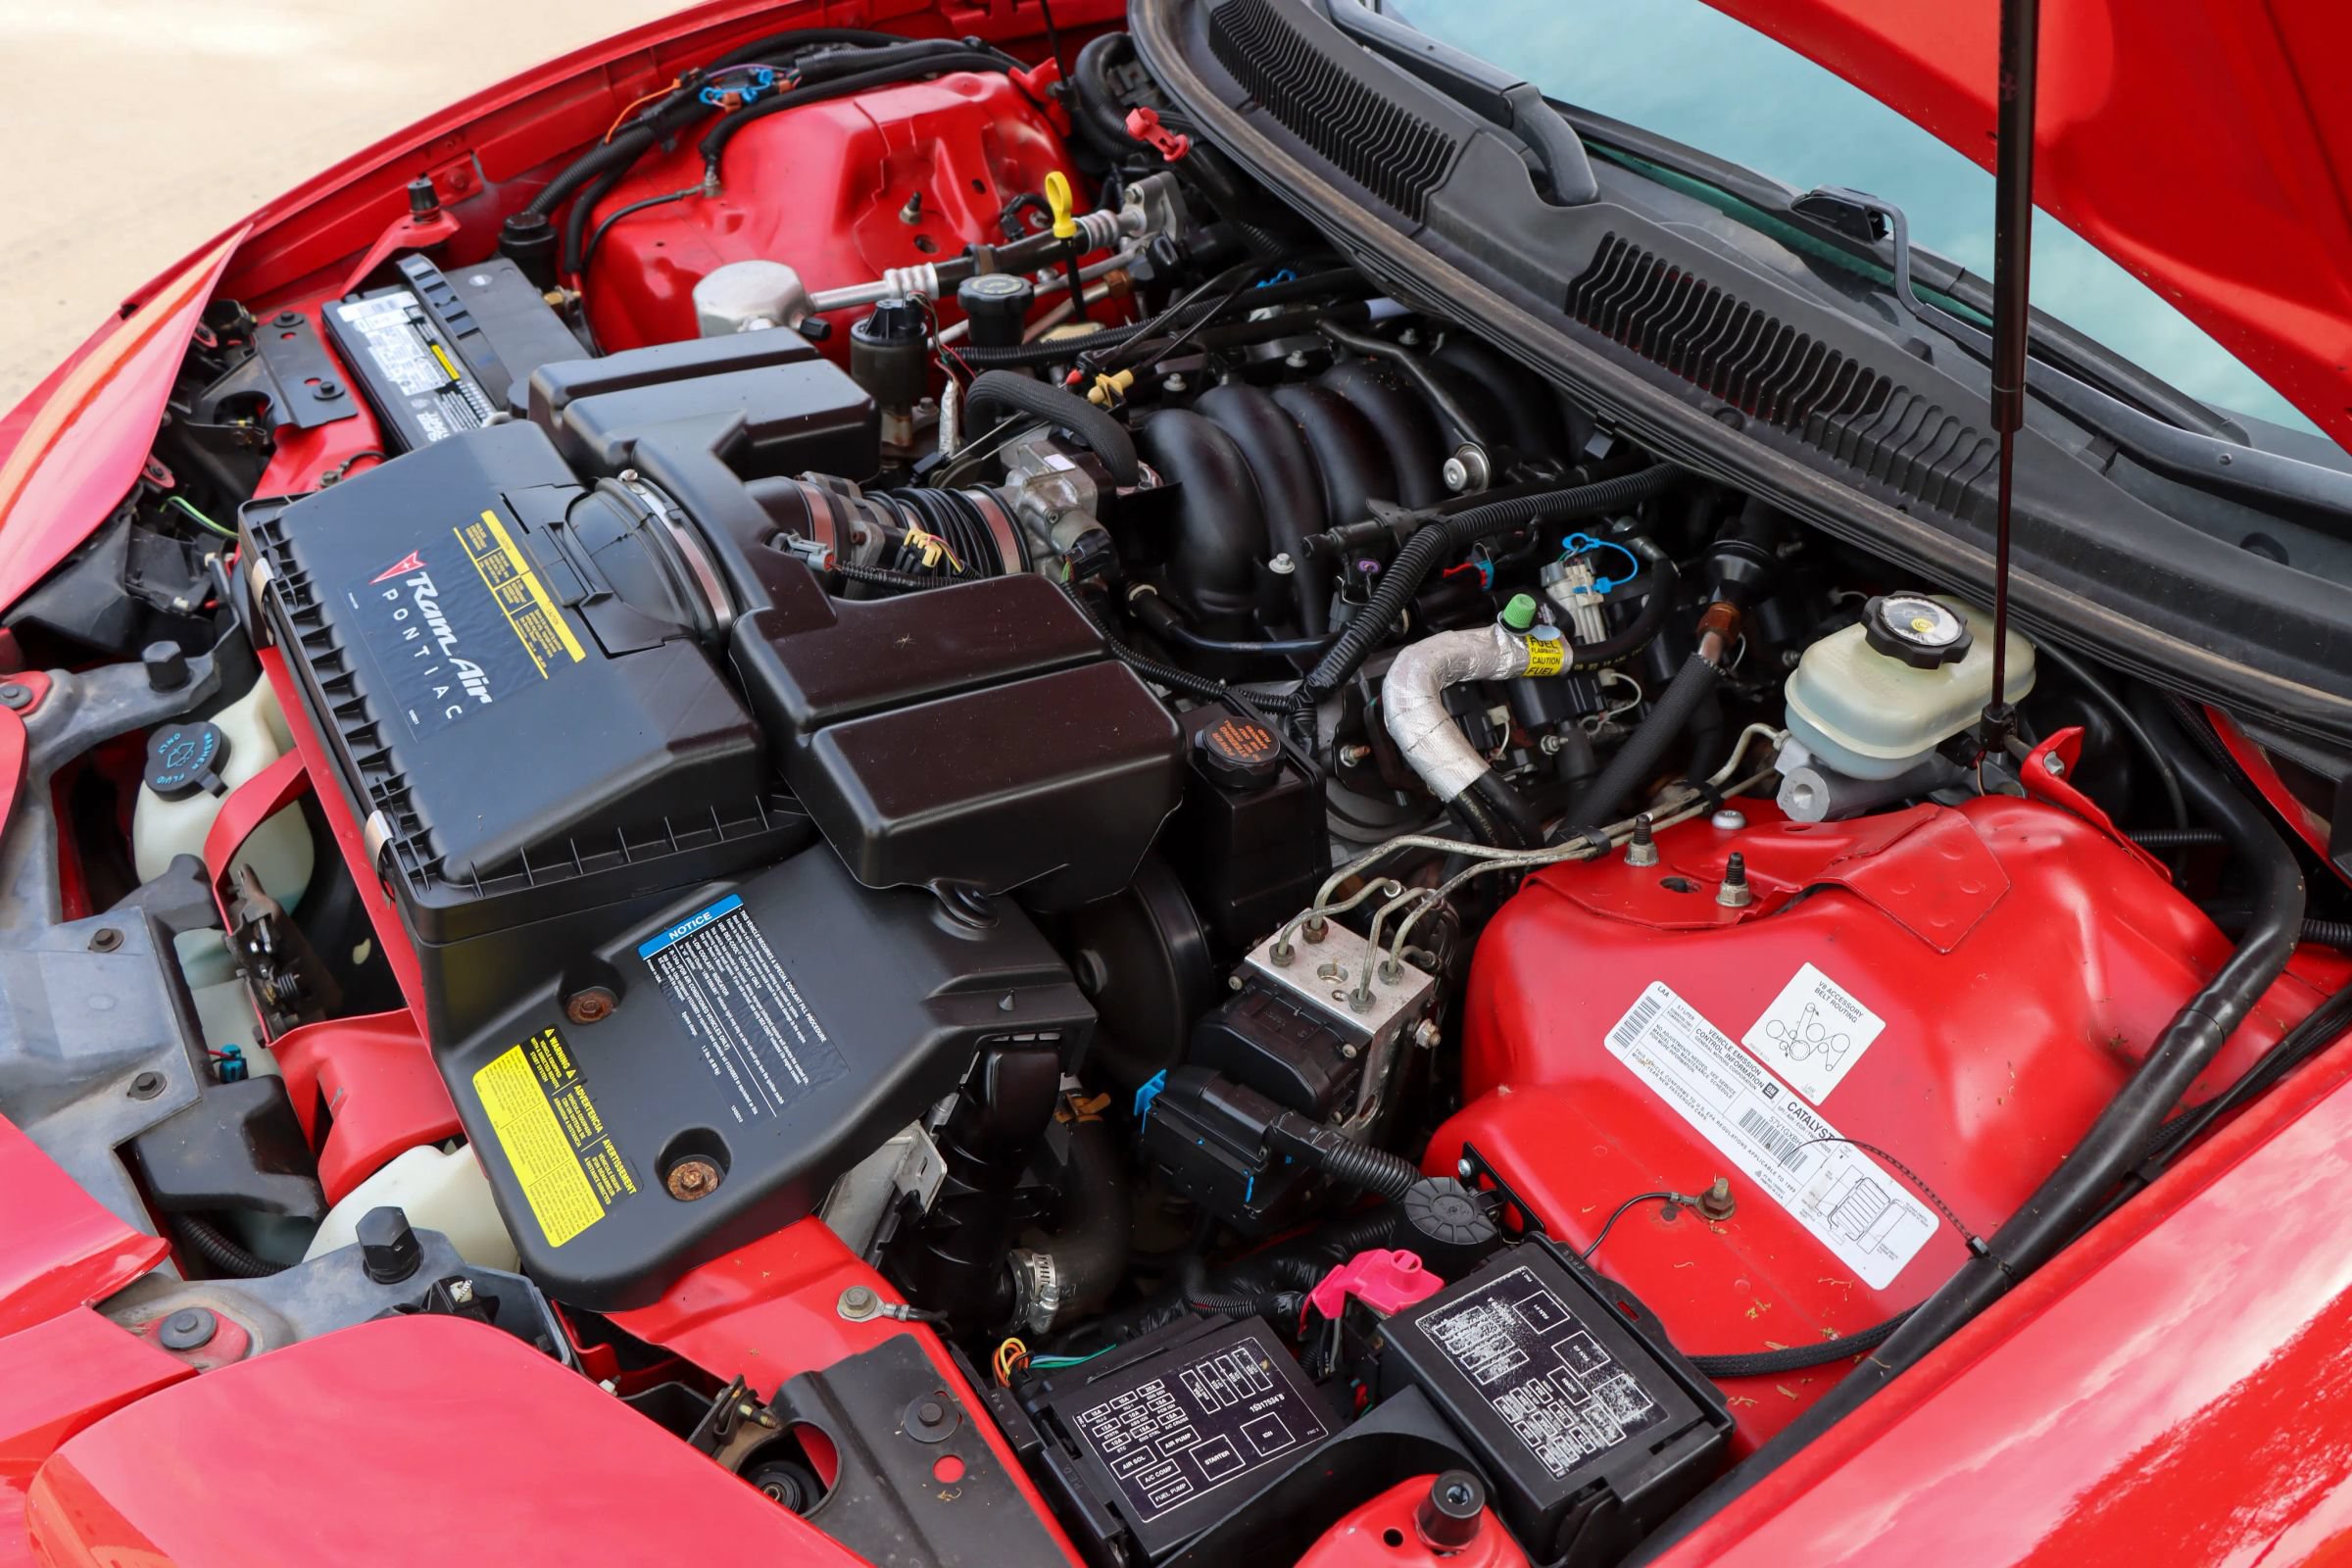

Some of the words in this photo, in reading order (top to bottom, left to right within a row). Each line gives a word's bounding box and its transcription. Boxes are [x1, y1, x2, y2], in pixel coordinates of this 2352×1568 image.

[381, 587, 463, 719] PONTIAC
[405, 571, 460, 657] Ram
[448, 658, 493, 705] Air
[1530, 636, 1558, 649] FUEL
[1526, 666, 1553, 675] FUEL
[1532, 656, 1560, 665] CAUTION
[158, 733, 180, 755] ONLY
[1212, 732, 1236, 757] POWER
[1219, 725, 1250, 758] STEERING
[1239, 728, 1250, 740] ONLY
[1245, 725, 1269, 750] APPROVED
[1257, 729, 1271, 743] FLUID
[191, 732, 213, 769] WASHER
[157, 772, 184, 784] FLUID
[667, 910, 712, 940] NOTICE
[716, 921, 726, 932] USE
[737, 955, 754, 977] COOLANT
[750, 976, 761, 990] ONLY
[710, 971, 729, 997] INDICATOR
[739, 909, 749, 920] THIS
[745, 919, 760, 938] VEHICLE
[756, 937, 774, 959] REQUIRES
[772, 962, 788, 982] SPECIAL
[784, 981, 802, 1004] COOLANT
[798, 1003, 808, 1014] FILL
[805, 1012, 827, 1043] PROCEDURE
[1656, 985, 1670, 998] LAA
[668, 949, 680, 965] R-134a
[676, 963, 687, 976] (FOR
[683, 974, 692, 984] AIR
[688, 982, 709, 1013] CONDITIONED
[705, 1012, 722, 1036] VEHICLES
[717, 1034, 730, 1051] ONLY)
[1813, 986, 1831, 1002] BELT
[1829, 999, 1858, 1023] ROUTING
[1817, 980, 1828, 990] V8
[1826, 987, 1863, 1018] ACCESSORY
[548, 1036, 570, 1070] WARNING
[1648, 1031, 1658, 1040] FOR
[1656, 1039, 1669, 1050] MORE
[1707, 1029, 1734, 1053] VEHICLE
[1732, 1050, 1761, 1076] EMISSION
[529, 1036, 539, 1050] WITH
[537, 1051, 551, 1072] DIRECTED
[547, 1070, 560, 1089] REMOTE
[529, 1051, 540, 1065] START
[536, 1063, 549, 1082] SYSTEM
[539, 1039, 552, 1057] VEHICLE
[548, 1055, 562, 1078] EQUIPPED
[1661, 1030, 1691, 1055] ADJUSTMENTS
[1709, 1070, 1719, 1080] SEE
[1718, 1078, 1736, 1095] SERVICE
[1669, 1043, 1680, 1053] AND
[1679, 1052, 1709, 1079] MAINTENANCE
[1709, 1077, 1733, 1099] SCHEDULE
[1693, 1036, 1713, 1053] GENERAL
[1712, 1051, 1730, 1066] MOTORS
[1728, 1064, 1757, 1090] CORPORATION
[1694, 1028, 1724, 1054] CONTROL
[1724, 1053, 1764, 1088] INFORMATION
[1658, 1076, 1669, 1087] NEW
[1668, 1085, 1694, 1109] PASSENGER
[1765, 1084, 1777, 1095] GM
[553, 1097, 568, 1121] ARRANQUE
[566, 1122, 582, 1148] DISTANCIA
[561, 1097, 569, 1108] CON
[568, 1112, 582, 1133] SISTEMA
[573, 1083, 604, 1133] ADVERTENCIA
[577, 1112, 592, 1136] EQUIPADO
[1644, 1057, 1664, 1075] VEHICLE
[1664, 1074, 1690, 1098] CONFORMS
[1705, 1111, 1715, 1120] EPA
[1715, 1119, 1746, 1150] REGULATIONS
[1747, 1149, 1777, 1176] APPLICABLE
[1786, 1100, 1836, 1145] CATALYST
[585, 1159, 600, 1183] DISTANCE
[596, 1181, 612, 1205] DIRECTED
[602, 1137, 637, 1196] AVERTISSEMENT
[1560, 1376, 1577, 1394] HORN
[1154, 1397, 1166, 1406] 15A
[1138, 1424, 1151, 1433] 15A
[1172, 1415, 1189, 1426] CRUISE
[1164, 1440, 1176, 1448] AIR
[1174, 1432, 1192, 1444] PUMP
[1121, 1460, 1133, 1469] AIR
[1132, 1454, 1146, 1464] SOL
[1202, 1448, 1231, 1465] STARTER
[1144, 1474, 1155, 1483] A/C
[1153, 1465, 1173, 1477] COMP
[1153, 1491, 1170, 1501] FUEL
[1169, 1483, 1187, 1494] PUMP
